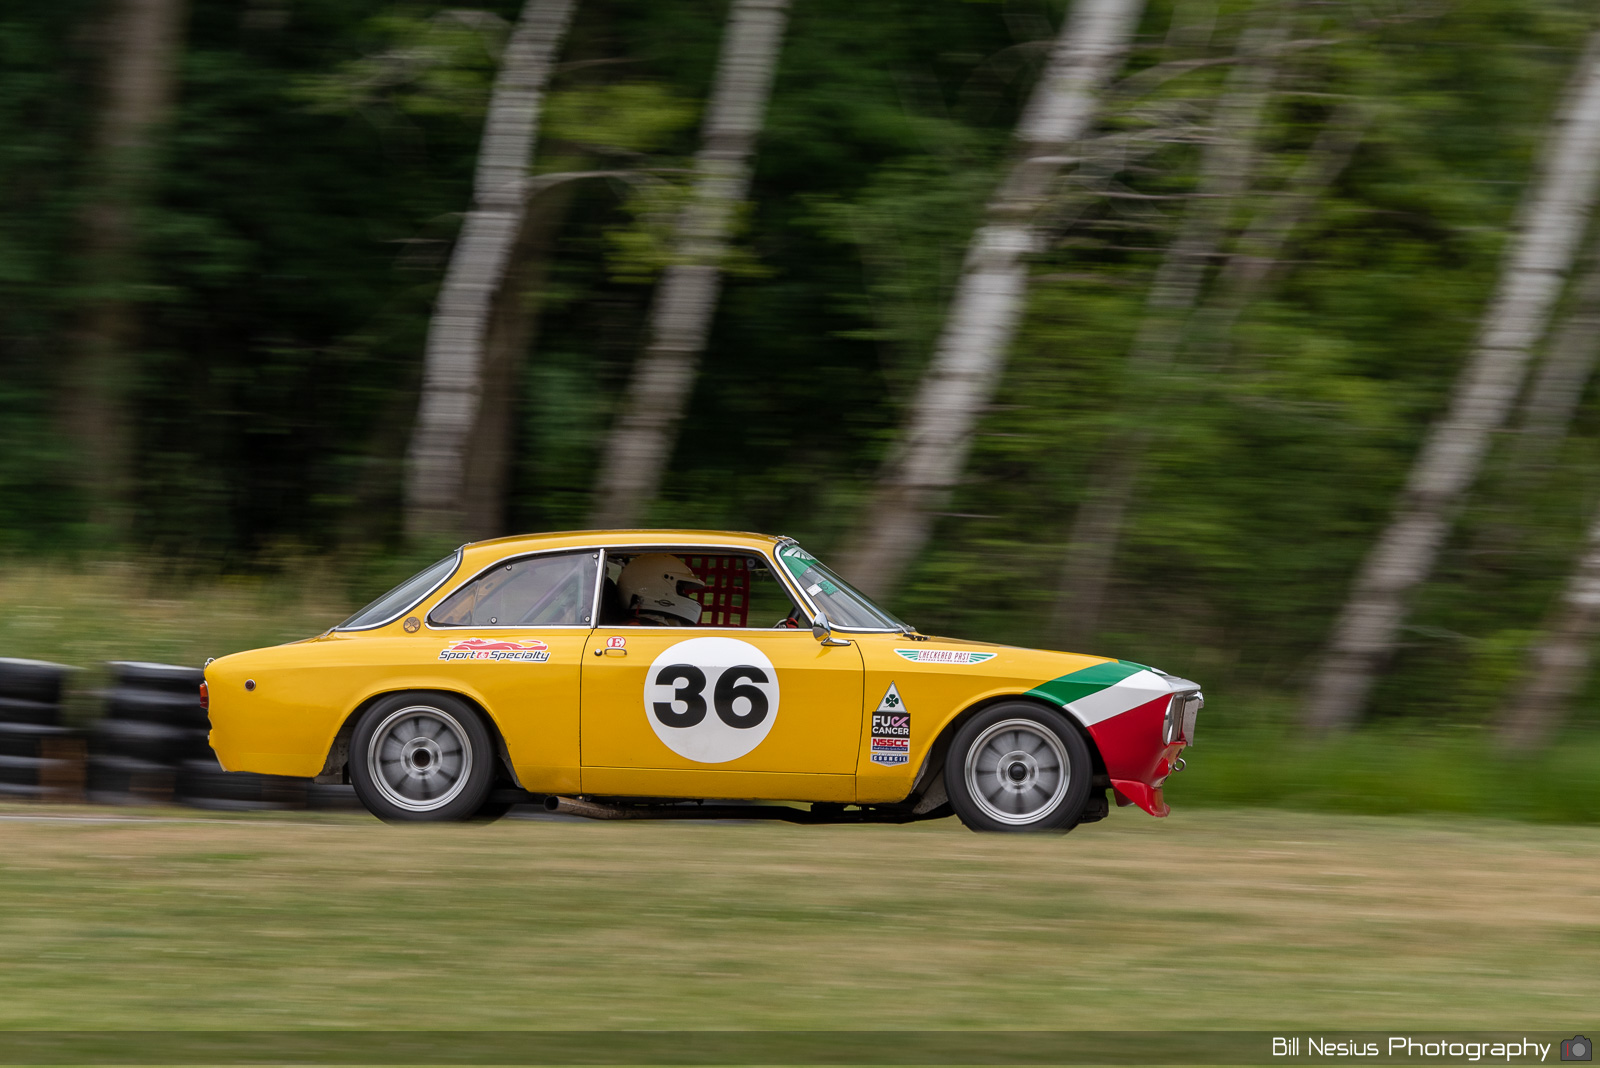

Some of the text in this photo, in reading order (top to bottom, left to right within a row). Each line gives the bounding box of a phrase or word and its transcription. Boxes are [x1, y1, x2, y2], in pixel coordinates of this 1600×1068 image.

[439, 650, 476, 660] Sport
[489, 650, 549, 661] Specialty
[919, 650, 952, 660] CHECKERED
[954, 652, 970, 661] PAST
[653, 663, 769, 730] 36
[872, 726, 909, 735] CANCER
[872, 738, 908, 747] NSSCC
